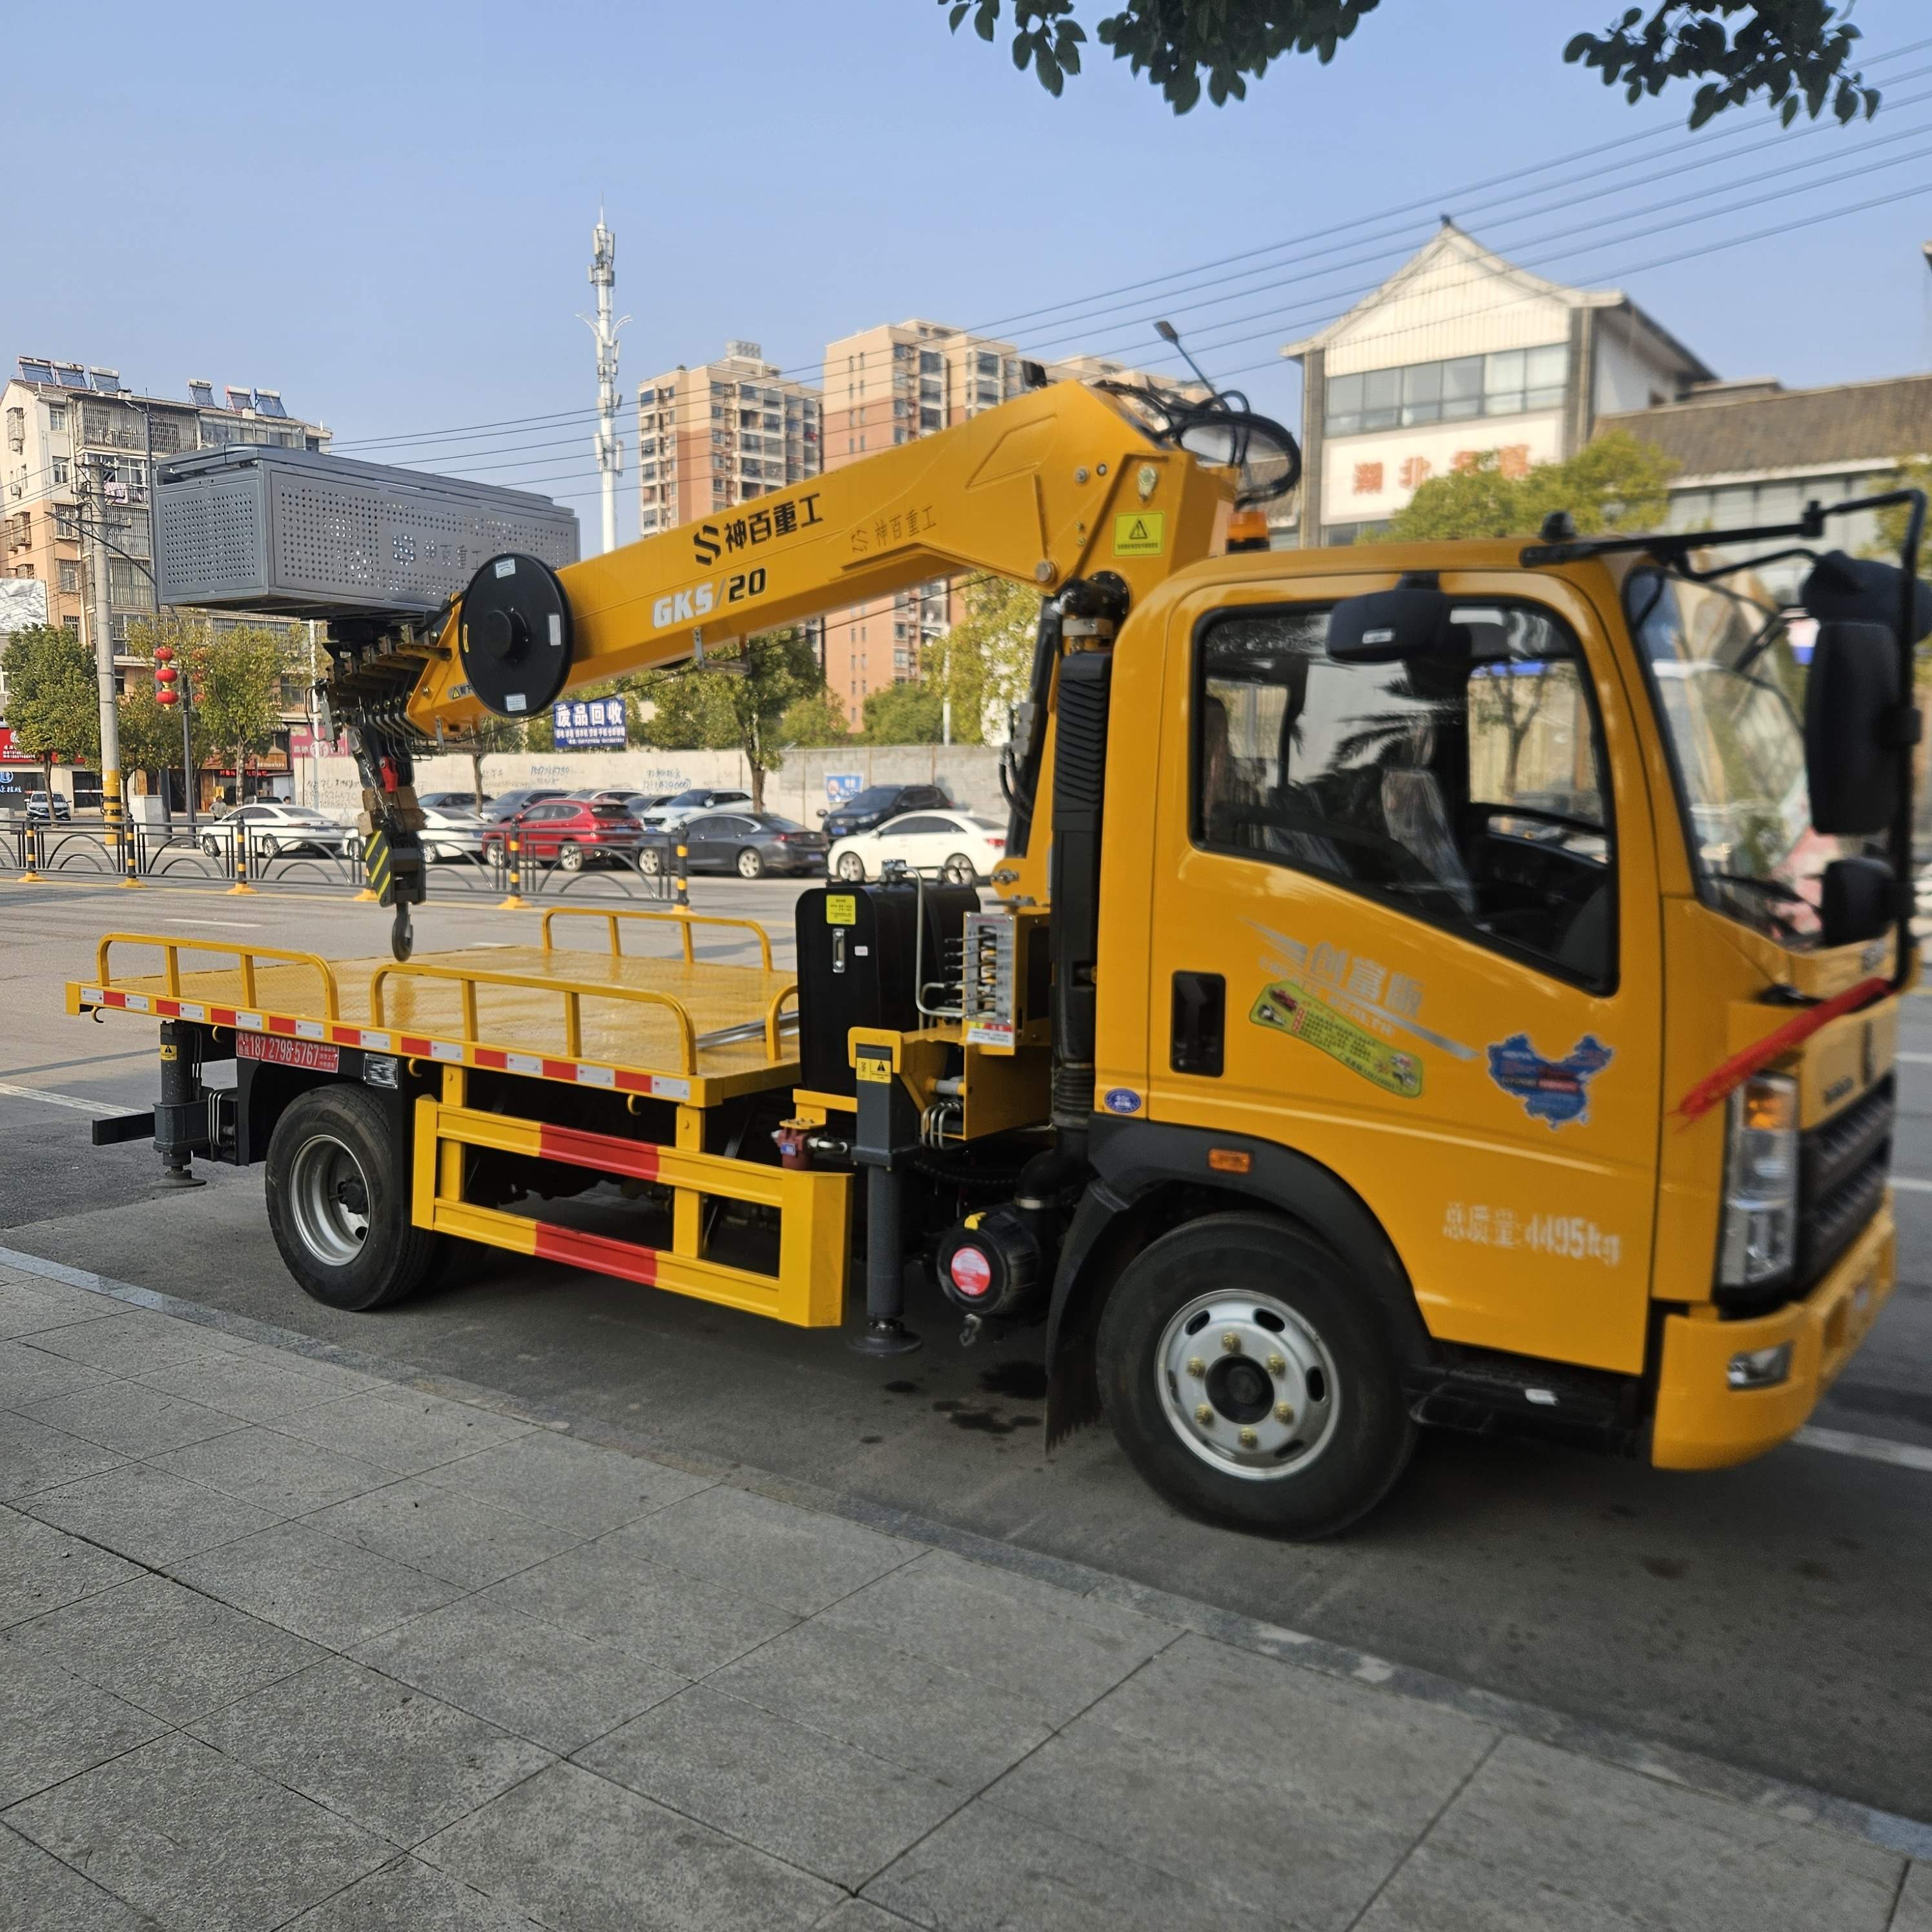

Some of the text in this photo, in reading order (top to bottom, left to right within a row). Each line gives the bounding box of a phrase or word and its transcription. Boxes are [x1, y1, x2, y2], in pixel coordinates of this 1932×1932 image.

[724, 493, 824, 553] 神百重工
[874, 505, 937, 548] 神百重工
[556, 700, 622, 728] 废品回收
[1310, 940, 1425, 1018] 创富版
[251, 1034, 320, 1066] 187 2798 5767
[1442, 1201, 1518, 1249] 总质量
